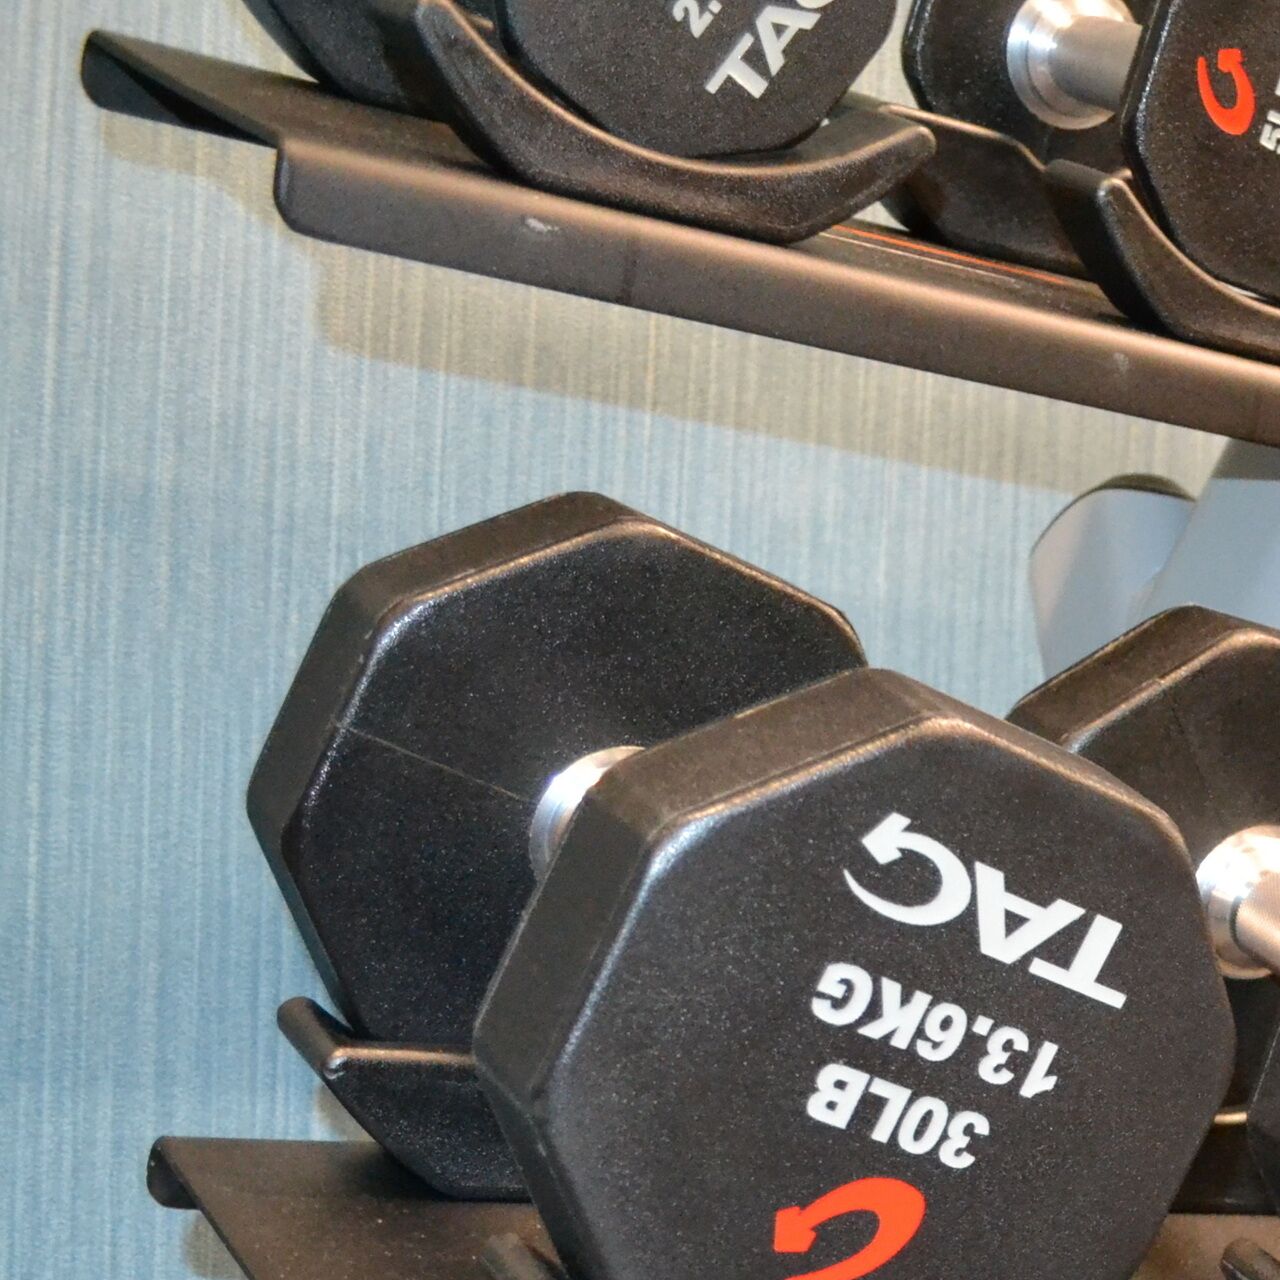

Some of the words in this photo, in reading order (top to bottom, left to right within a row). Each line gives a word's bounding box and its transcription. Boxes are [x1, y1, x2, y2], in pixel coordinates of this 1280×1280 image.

[704, 0, 833, 99] TA
[843, 812, 1128, 1010] TAG
[811, 961, 1060, 1099] 13.6KG
[806, 1062, 991, 1170] 30LB
